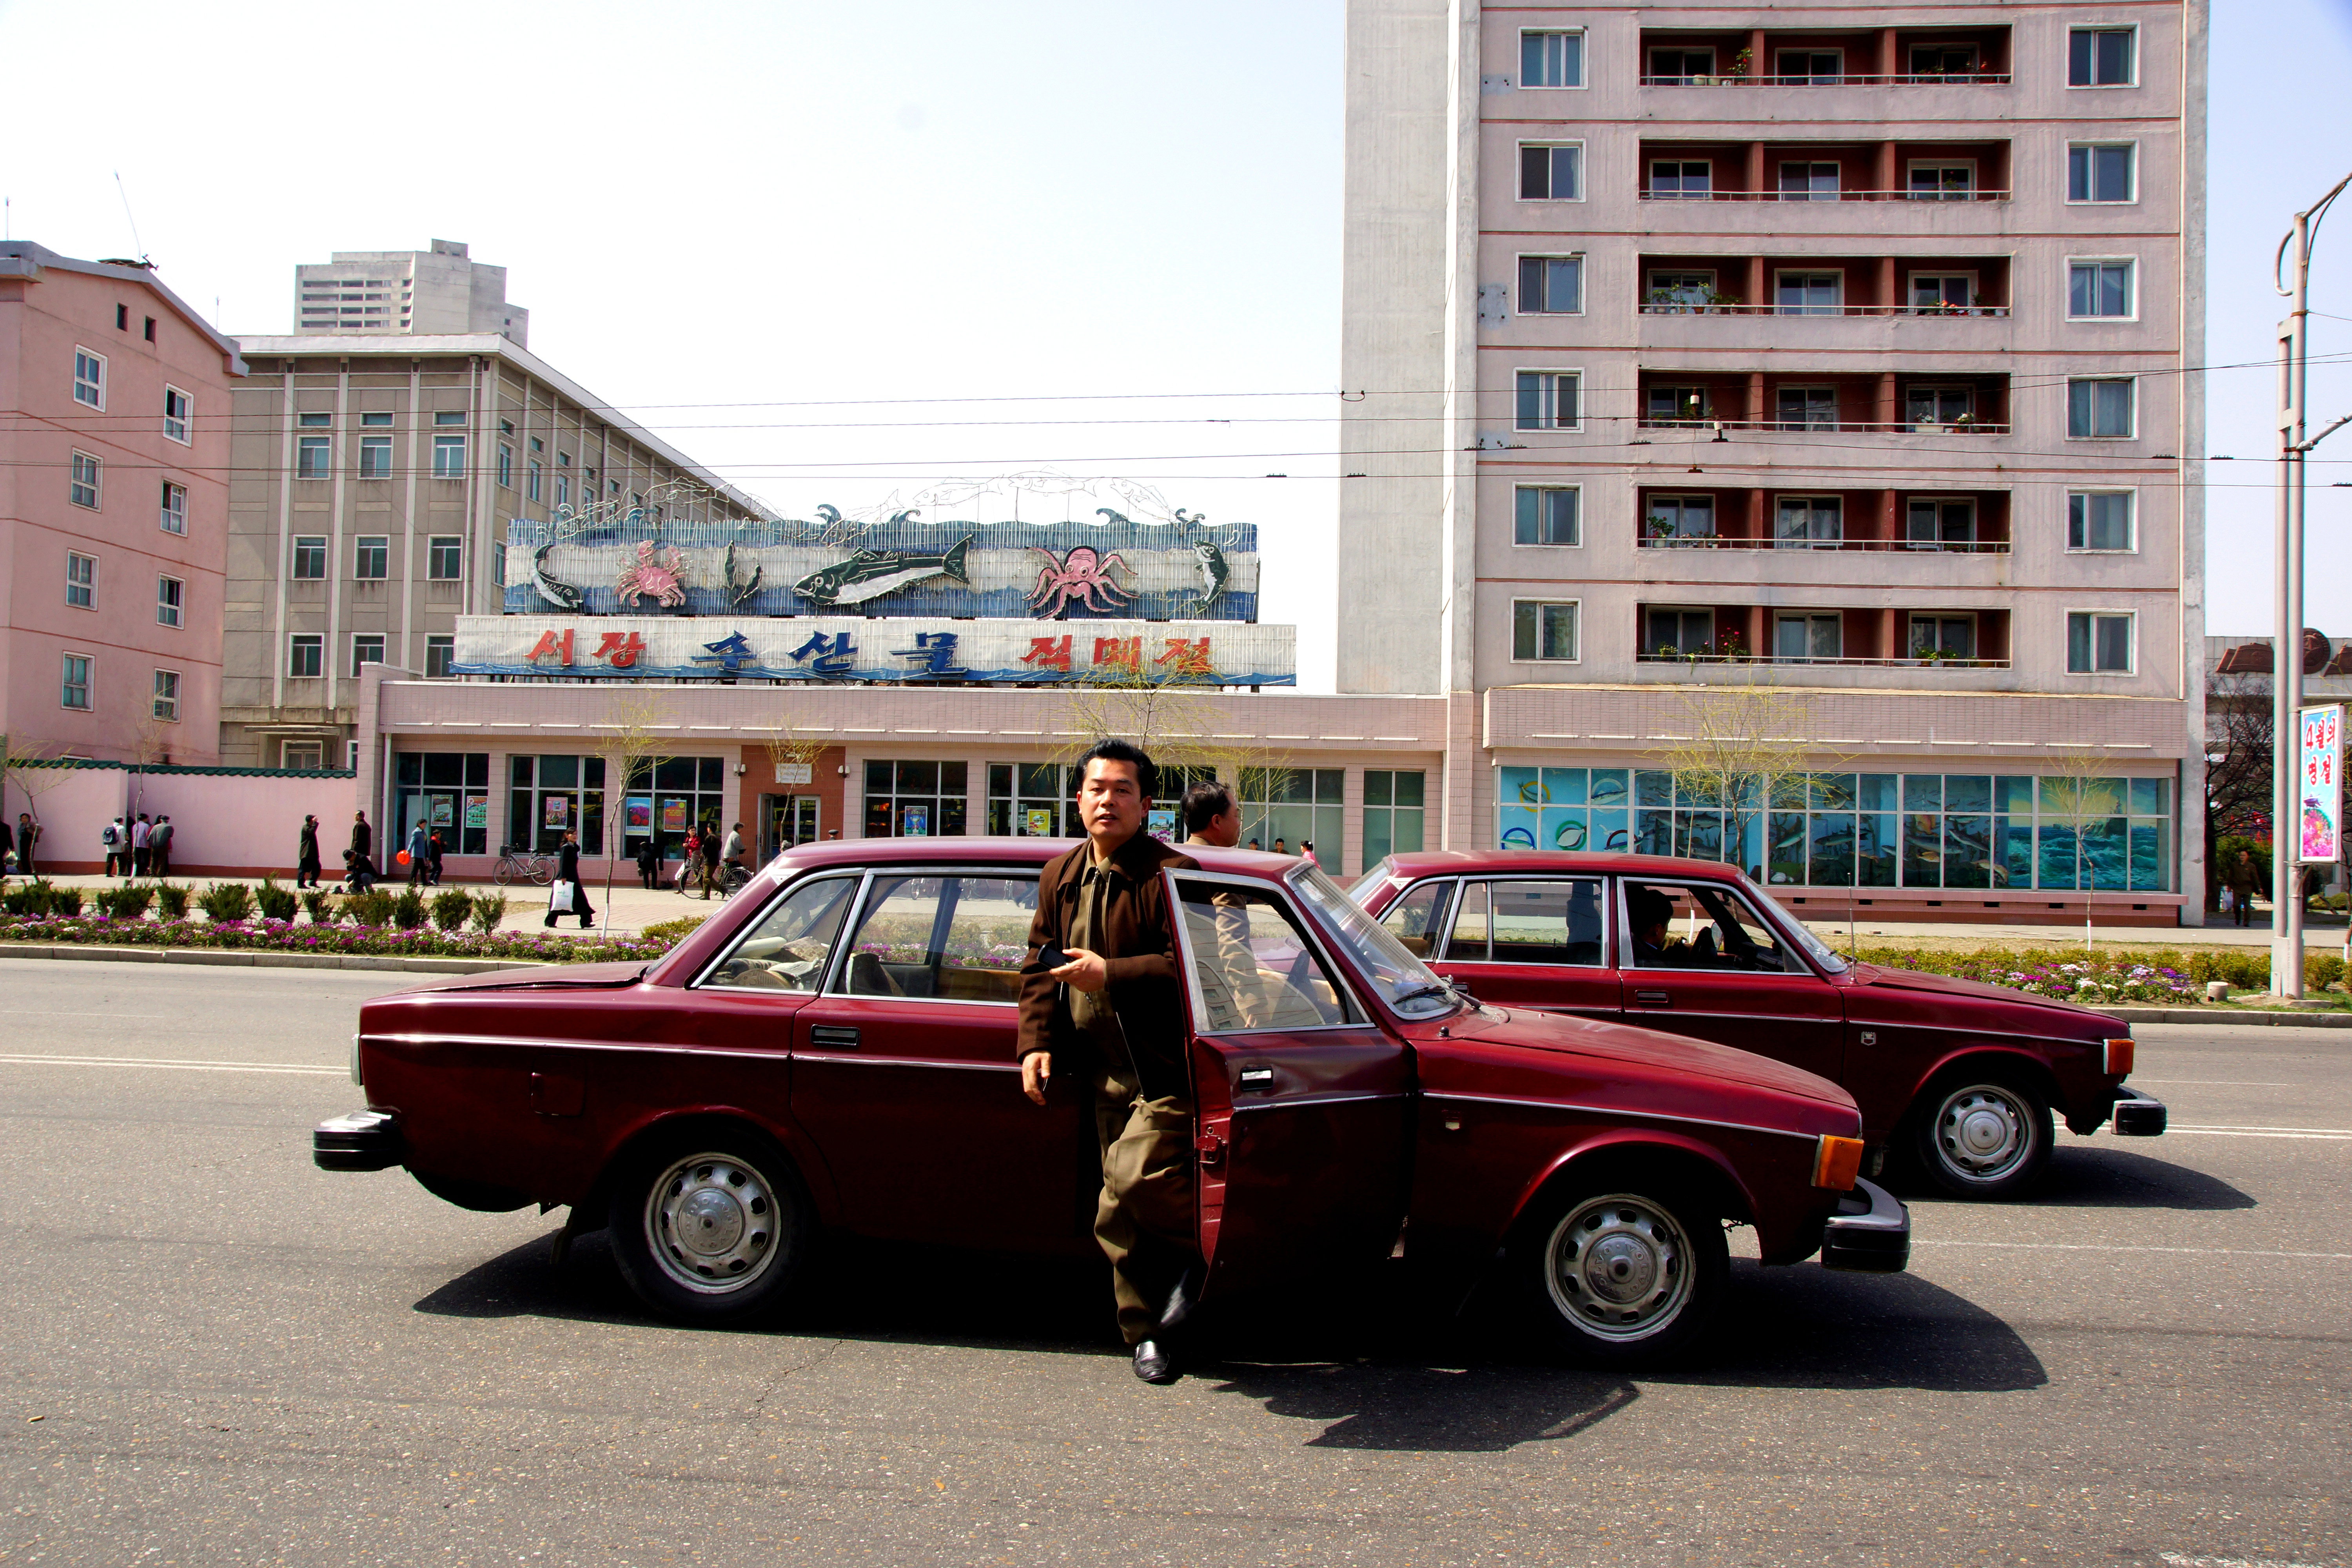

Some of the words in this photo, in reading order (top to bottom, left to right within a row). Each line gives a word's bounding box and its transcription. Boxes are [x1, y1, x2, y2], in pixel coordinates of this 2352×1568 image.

[522, 627, 647, 667] 서장
[689, 629, 969, 674] 수산물
[1018, 634, 1213, 673] 직매점
[2306, 718, 2336, 749] 4월의
[2308, 755, 2331, 785] 명절
[1594, 1247, 1617, 1295] VOLVO
[1625, 1241, 1648, 1292] VOLVO
